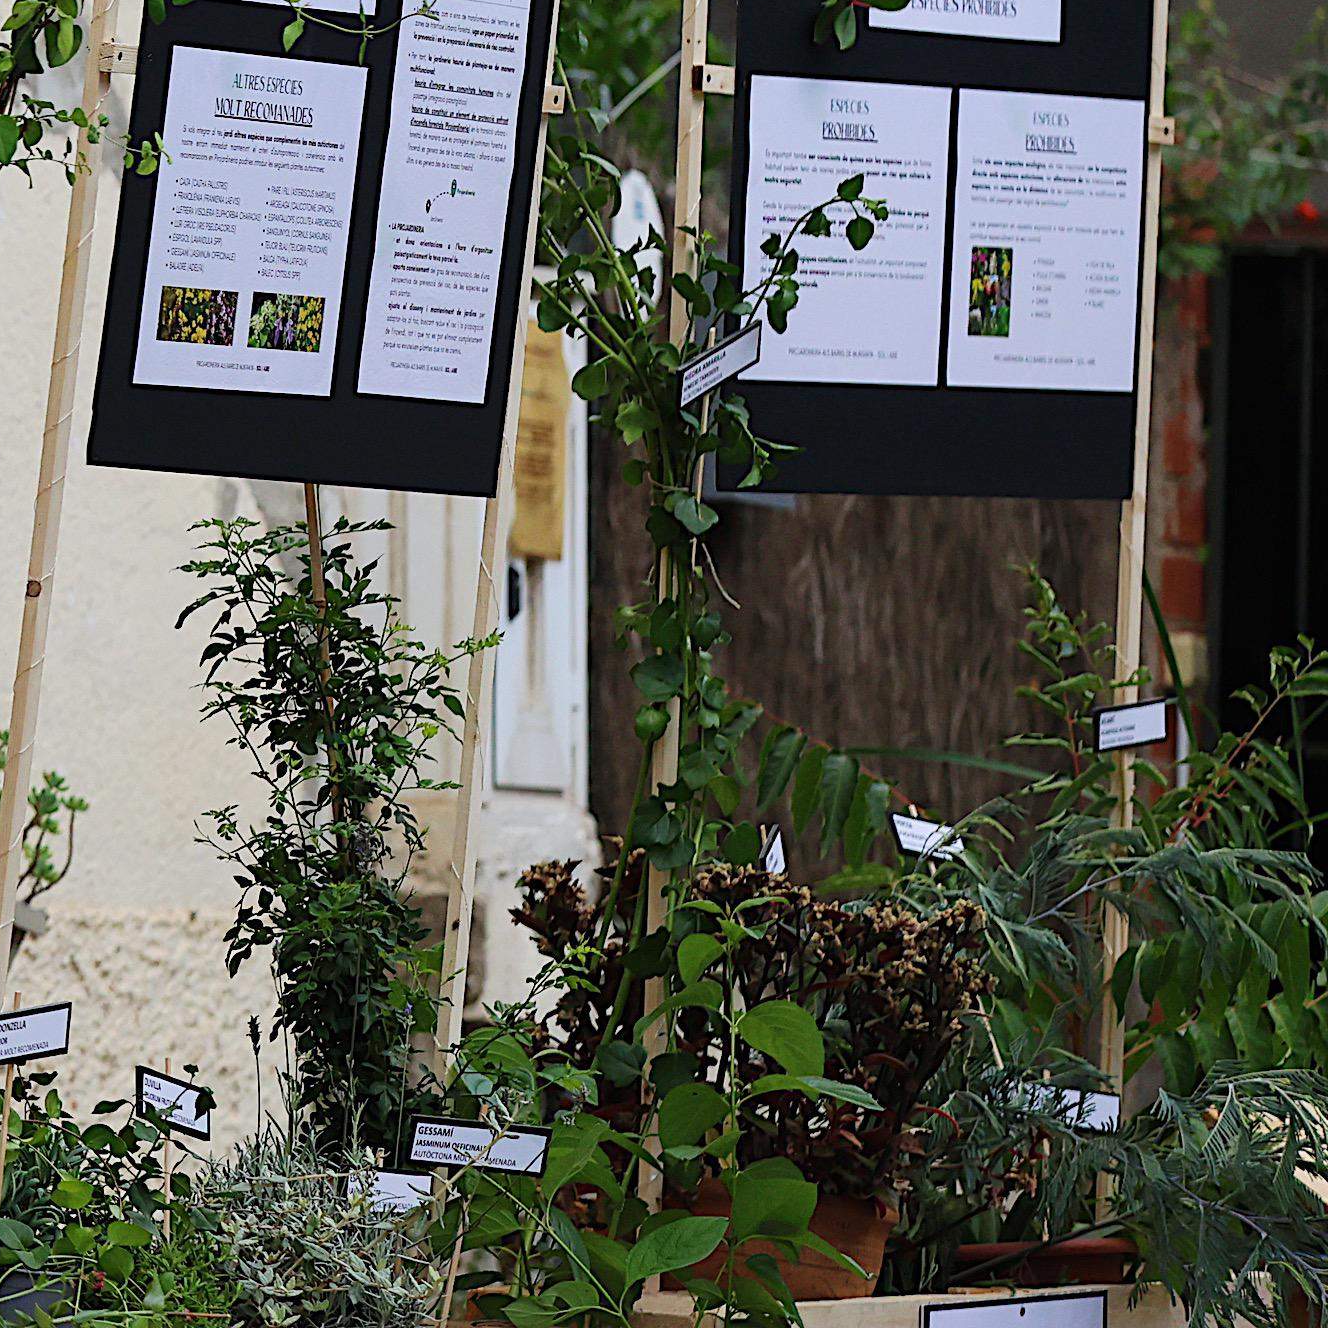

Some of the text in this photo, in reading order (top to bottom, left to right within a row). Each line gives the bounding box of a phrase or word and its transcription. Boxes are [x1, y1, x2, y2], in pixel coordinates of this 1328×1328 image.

[232, 73, 264, 91] ALTRES
[216, 98, 313, 125] MOLT RECOMANADES
[822, 122, 875, 139] PROHIBIDES
[418, 1126, 454, 1137] GESSAMÍ
[416, 1139, 451, 1149] JASMINUM
